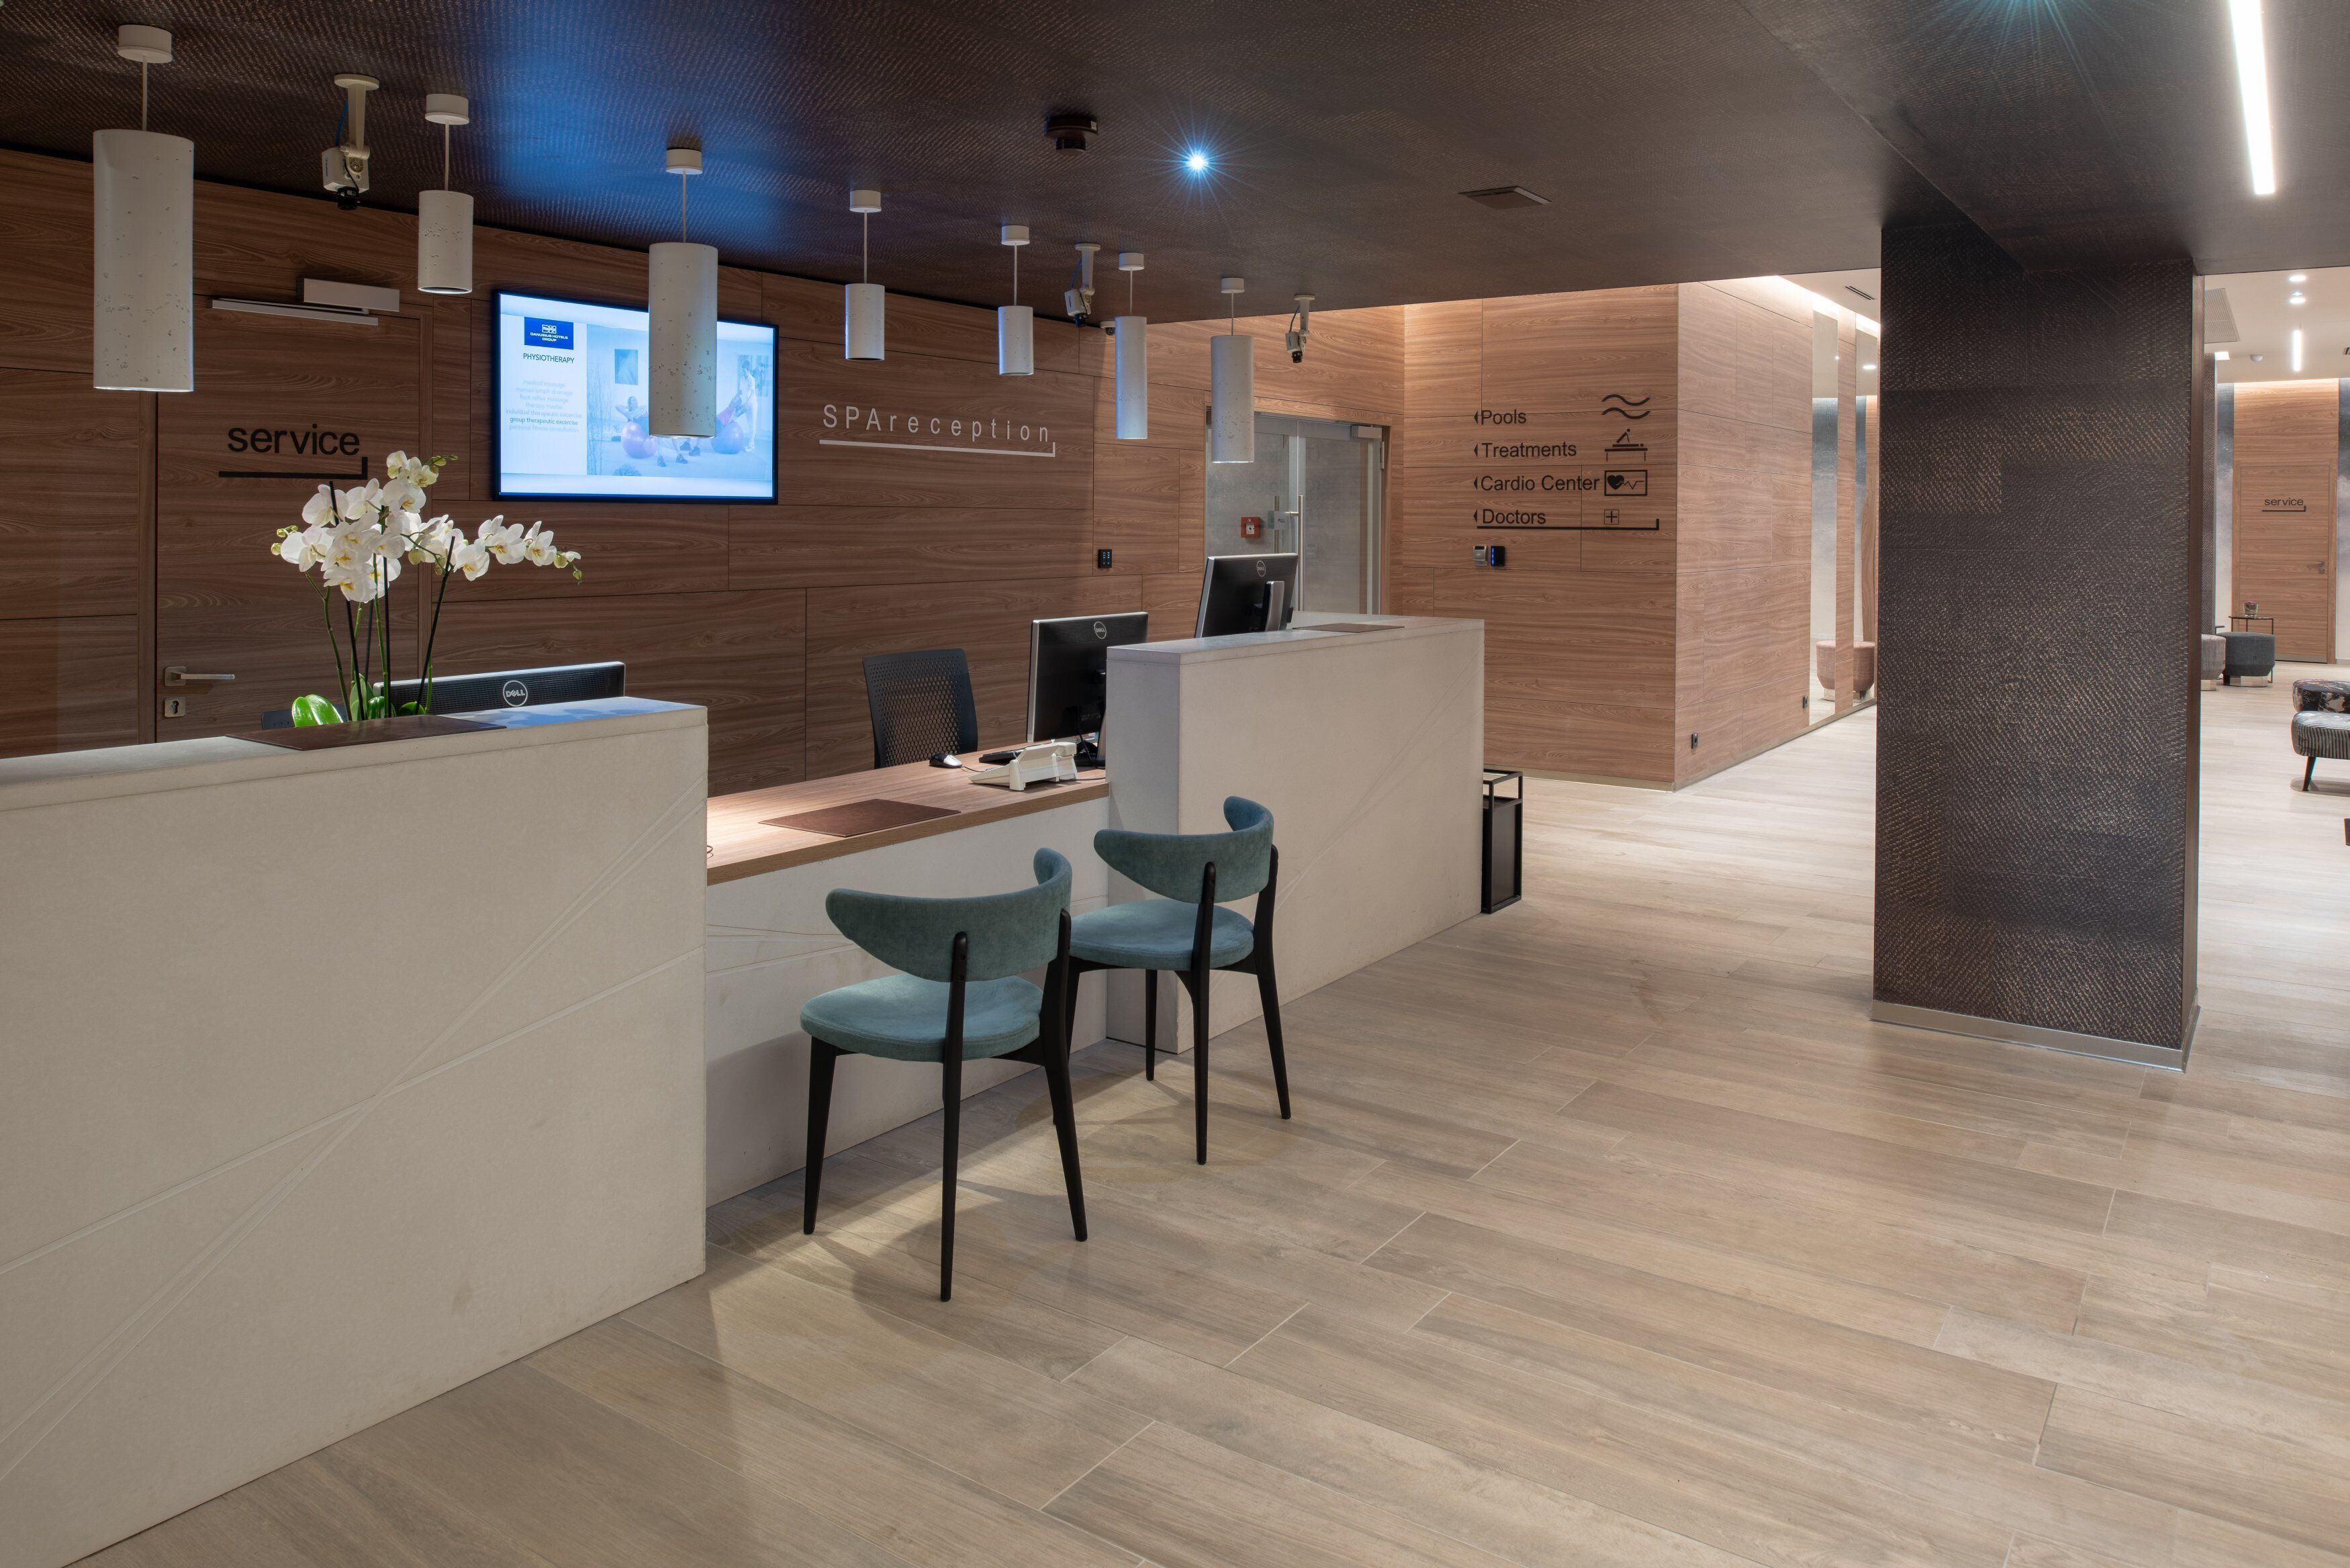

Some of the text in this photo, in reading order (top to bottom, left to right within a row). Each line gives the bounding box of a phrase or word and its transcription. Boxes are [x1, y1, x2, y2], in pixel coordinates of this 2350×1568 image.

[523, 352, 575, 364] PHYSIOTHERAPY
[530, 409, 559, 418] therapeutic
[1480, 409, 1526, 425] Pools
[526, 417, 555, 425] therapeutic
[227, 424, 360, 456] service
[1481, 442, 1577, 458] Treatments
[1480, 475, 1600, 491] Cardio Center
[2264, 497, 2304, 506] service
[1483, 509, 1546, 524] Doctors
[506, 689, 525, 697] DELL
